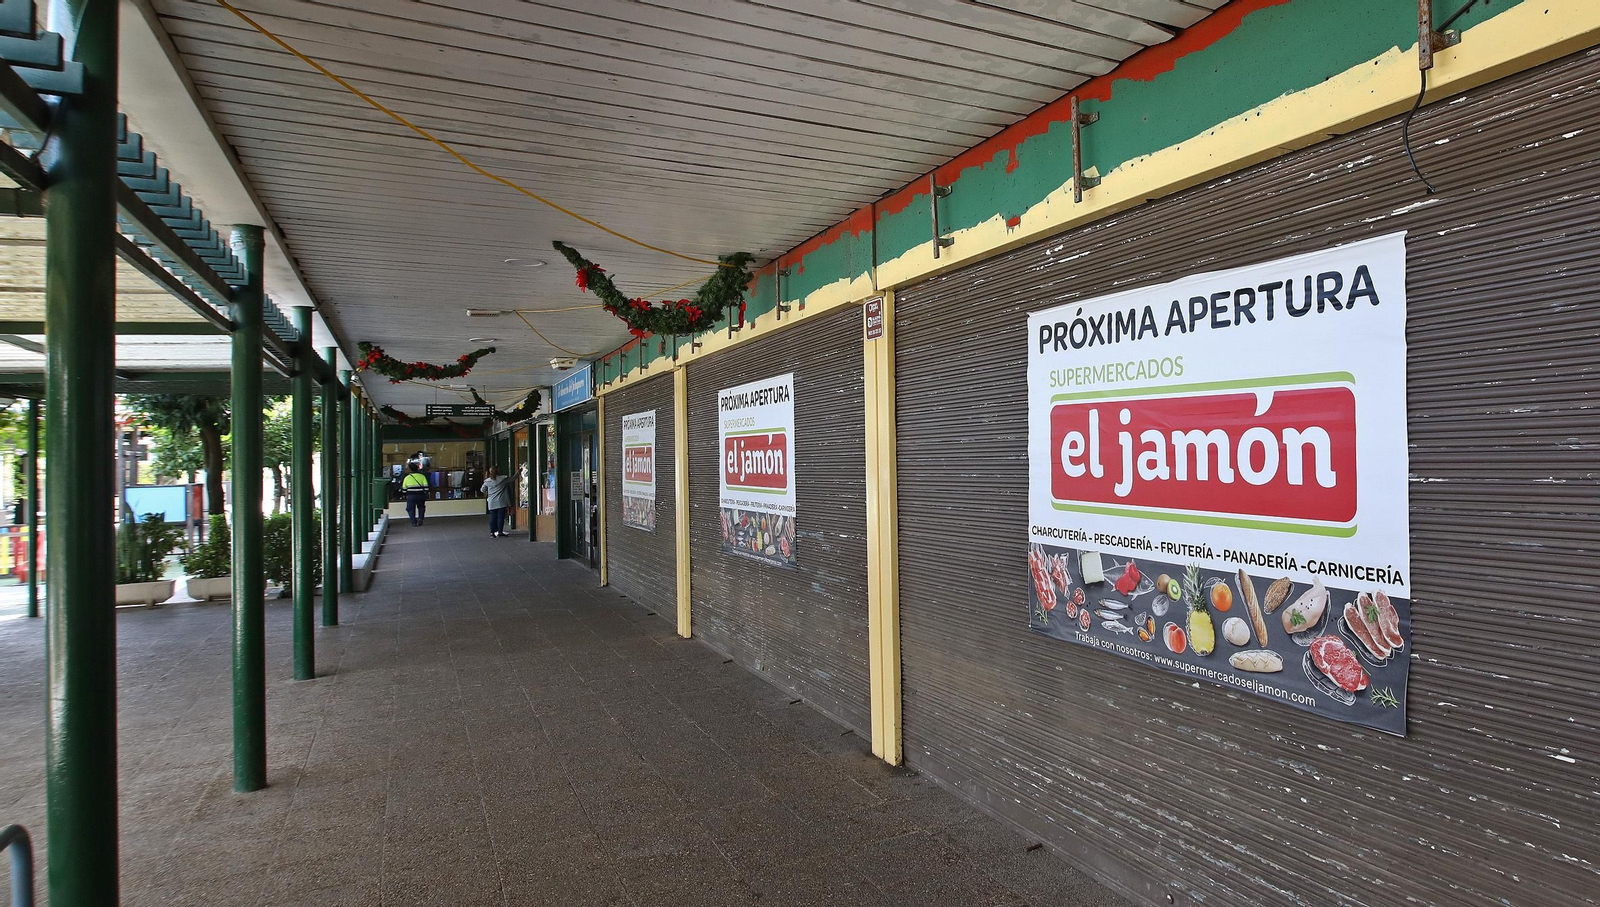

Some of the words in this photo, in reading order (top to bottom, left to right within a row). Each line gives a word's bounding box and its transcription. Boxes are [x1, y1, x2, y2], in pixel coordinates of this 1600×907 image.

[1039, 305, 1159, 354] PRÓXIMA
[1164, 264, 1381, 337] APERTURA
[1049, 356, 1184, 388] SUPERMERCADOS
[721, 390, 750, 412] PRÓXIMA
[750, 384, 790, 408] APERTURA
[626, 450, 632, 472] el
[728, 440, 739, 474] el
[740, 434, 783, 482] jamón
[1060, 408, 1104, 478] el
[1113, 391, 1337, 497] jamón
[1031, 524, 1088, 543] CHARCUTERÍA
[1094, 532, 1152, 551] PESCADERÍA
[1160, 541, 1214, 560] FRUTERÍA
[1223, 549, 1298, 572] PANADERÍA
[1074, 630, 1100, 648] Trabaja
[1101, 640, 1115, 650] con
[1116, 643, 1153, 661] nosotros:
[1154, 654, 1317, 707] www.supermercadoseljamon.com
